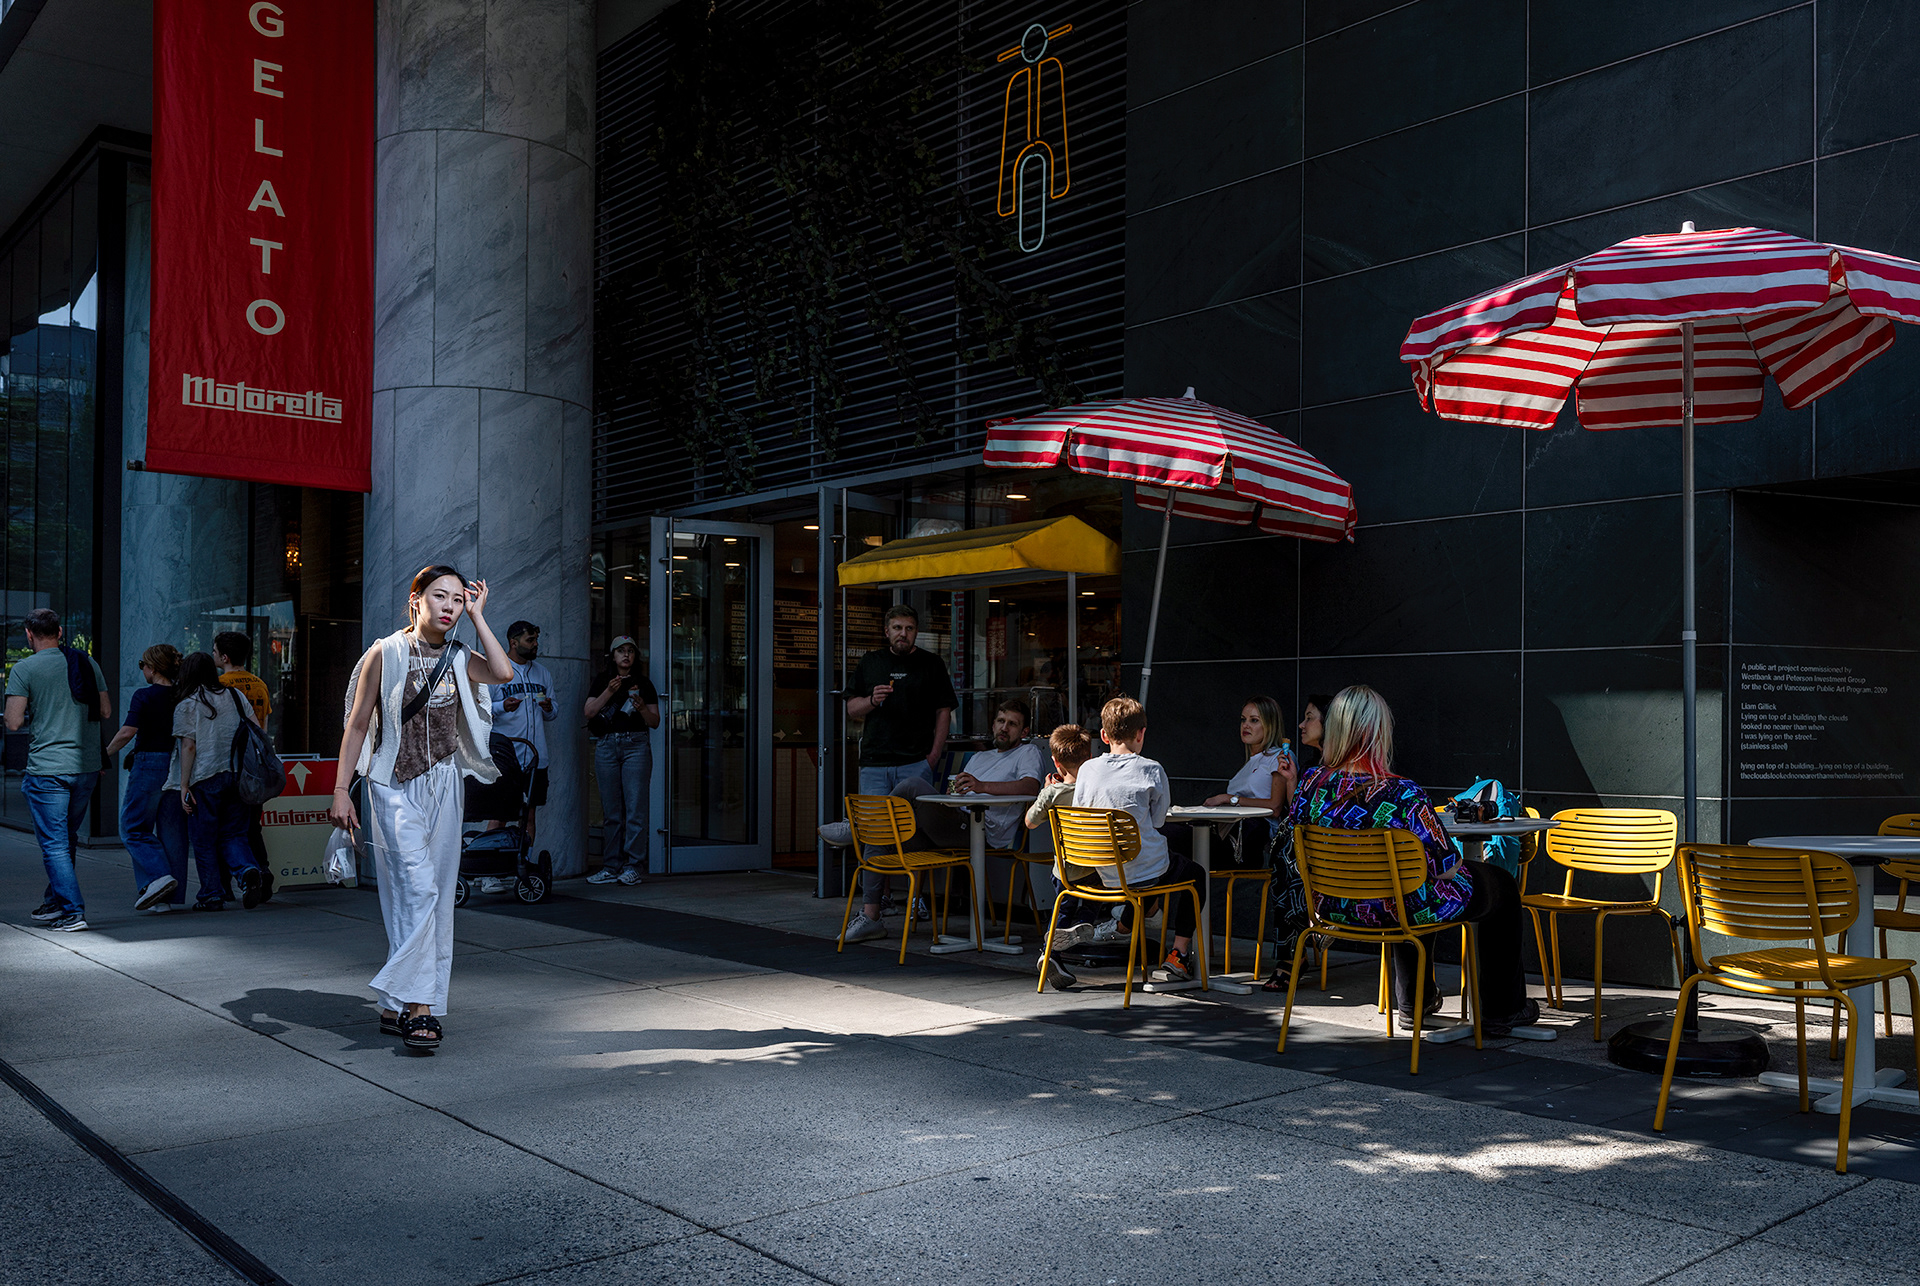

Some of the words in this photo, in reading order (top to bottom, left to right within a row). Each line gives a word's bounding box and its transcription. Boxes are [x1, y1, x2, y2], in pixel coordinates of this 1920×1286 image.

[246, 0, 286, 336] GELATO
[181, 373, 343, 424] Motoretta
[1741, 662, 1747, 670] A
[1748, 663, 1766, 672] public
[1778, 664, 1800, 672] project
[1800, 665, 1844, 673] commissioned
[1741, 672, 1772, 681] Westbank
[1786, 674, 1814, 682] Peterson
[1814, 675, 1848, 683] Investment
[1848, 676, 1866, 684] Group
[500, 683, 547, 700] MARINER
[1741, 682, 1750, 690] for
[1762, 683, 1775, 692] City
[1784, 684, 1816, 692] Vancouver
[1874, 686, 1888, 694] 2009
[1741, 702, 1756, 710] Liam
[1741, 712, 1758, 722] Lying
[1768, 714, 1779, 722] top
[1792, 714, 1817, 722] building
[1828, 714, 1848, 722] clouds
[1740, 722, 1762, 730] looked
[1758, 732, 1774, 742] lying
[1740, 742, 1770, 751] (stainless
[1740, 762, 1756, 770] lying
[1776, 762, 1784, 770] of
[261, 808, 332, 827] Motoret
[281, 866, 325, 877] GELAT
